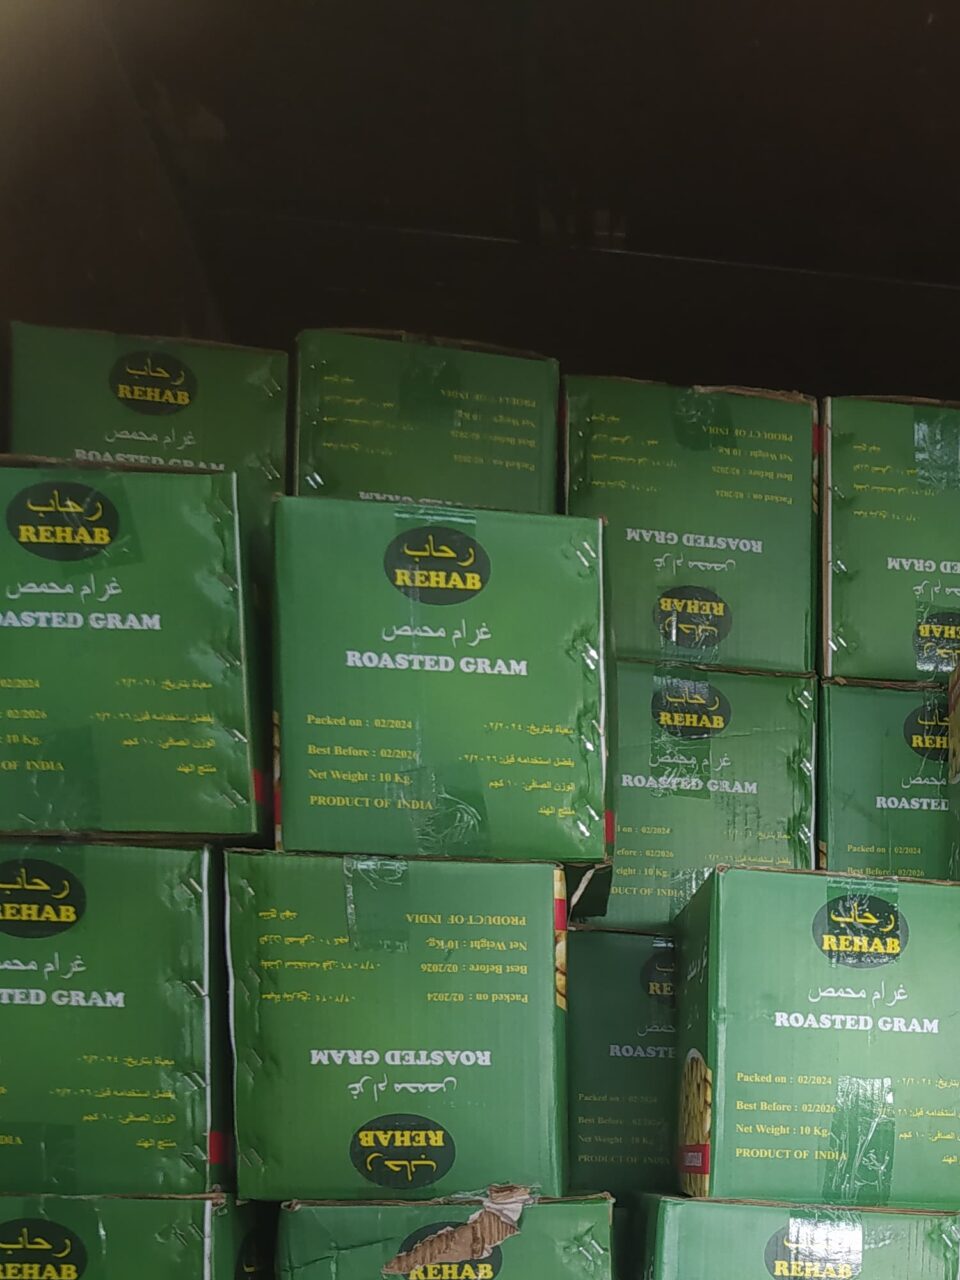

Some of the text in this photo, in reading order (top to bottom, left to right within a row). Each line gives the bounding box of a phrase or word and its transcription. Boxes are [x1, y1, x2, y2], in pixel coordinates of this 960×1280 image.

[118, 384, 189, 405] REHAB
[27, 490, 102, 520] رحاب
[19, 526, 110, 544] REHAB
[626, 528, 763, 553] ROASTED GRAM
[404, 536, 474, 566] رحاب
[395, 569, 481, 589] REHAB
[660, 597, 725, 616] REHAB
[0, 611, 161, 630] ASTED GRAM
[383, 620, 491, 646] غرام محمص
[347, 651, 527, 675] ROASTED GRAM
[660, 712, 724, 728] REHAB
[622, 773, 757, 793] ROASTED GRAM
[0, 904, 77, 922] EHAB
[406, 913, 527, 926] PRODUCT OF INDIA
[831, 901, 897, 932] رحاب
[822, 935, 900, 954] REHAB
[52, 990, 124, 1007] GRAM
[809, 981, 907, 1008] غرام محمص
[775, 1012, 938, 1033] ROASTED GRAM
[311, 1050, 491, 1065] ROASTED GRAM
[348, 1074, 456, 1101] غرام محمص
[736, 1072, 772, 1083] Packed
[774, 1075, 787, 1083] on
[797, 1075, 832, 1085] 02/2024
[736, 1100, 757, 1110] Best
[760, 1100, 792, 1111] Before
[801, 1103, 836, 1113] 02/2026
[359, 1131, 444, 1146] REHAB
[736, 1124, 752, 1134] Net
[755, 1124, 790, 1137] Weight
[799, 1127, 811, 1136] 10
[813, 1127, 831, 1138] Kg.
[736, 1148, 848, 1161] PRODUCT OF INDIA
[367, 1153, 436, 1180] رحاب
[0, 1263, 78, 1280] EHAB
[774, 1259, 853, 1279] REHAB
